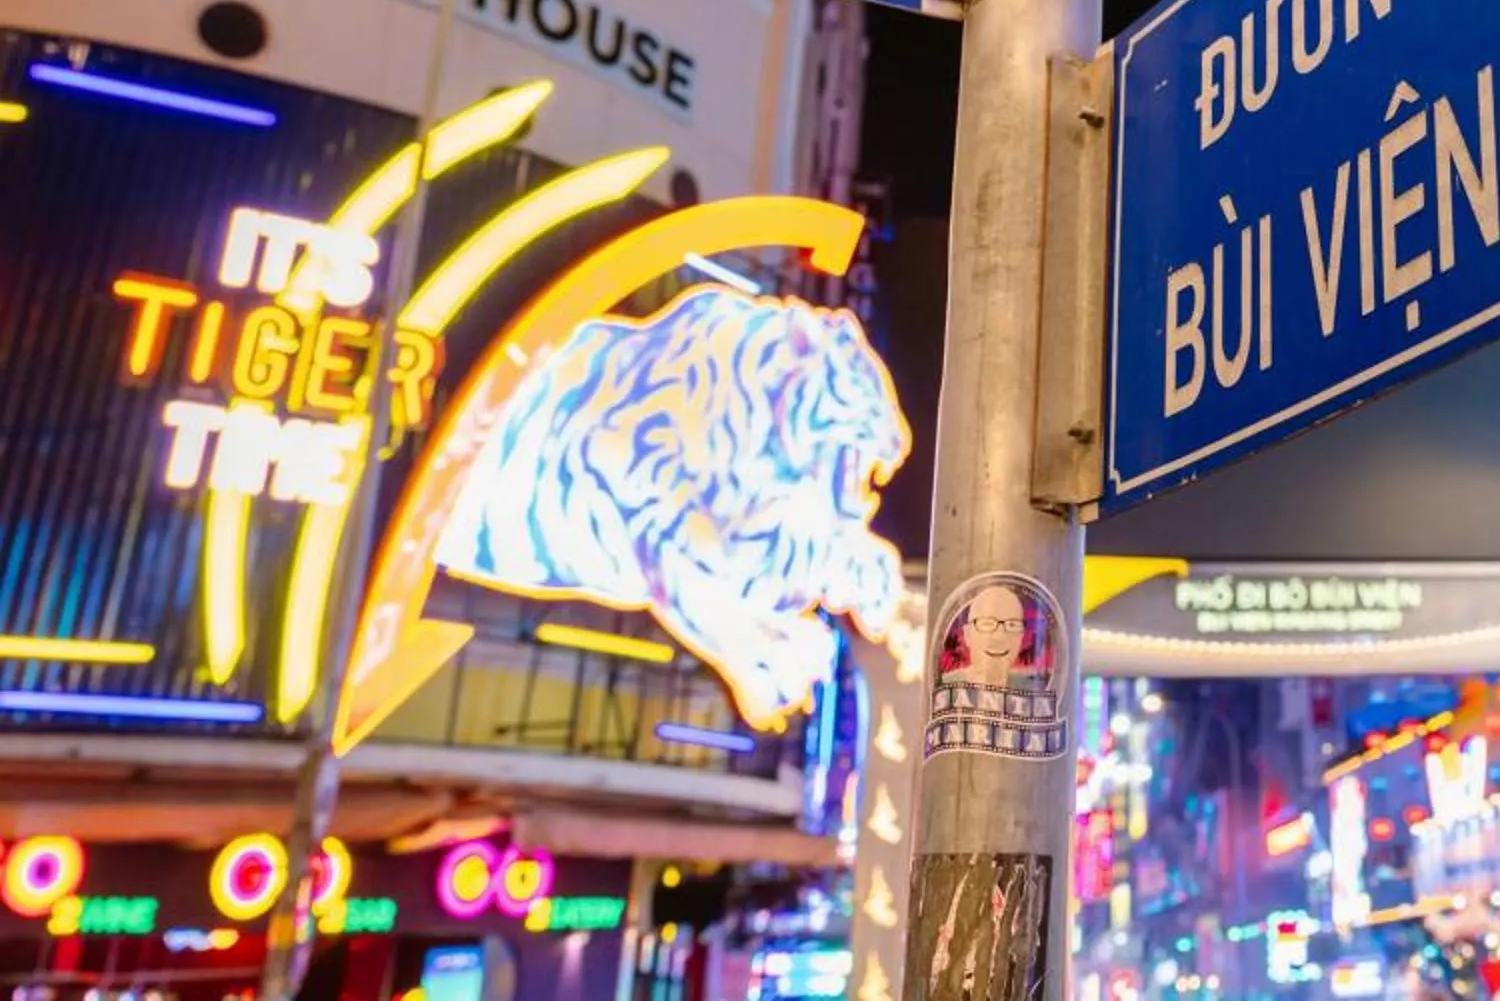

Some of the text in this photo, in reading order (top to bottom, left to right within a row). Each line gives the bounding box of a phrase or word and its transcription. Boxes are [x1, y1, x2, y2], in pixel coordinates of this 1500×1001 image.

[113, 279, 437, 425] TIGER
[1164, 194, 1273, 419] BÙI
[163, 400, 361, 502] TIME
